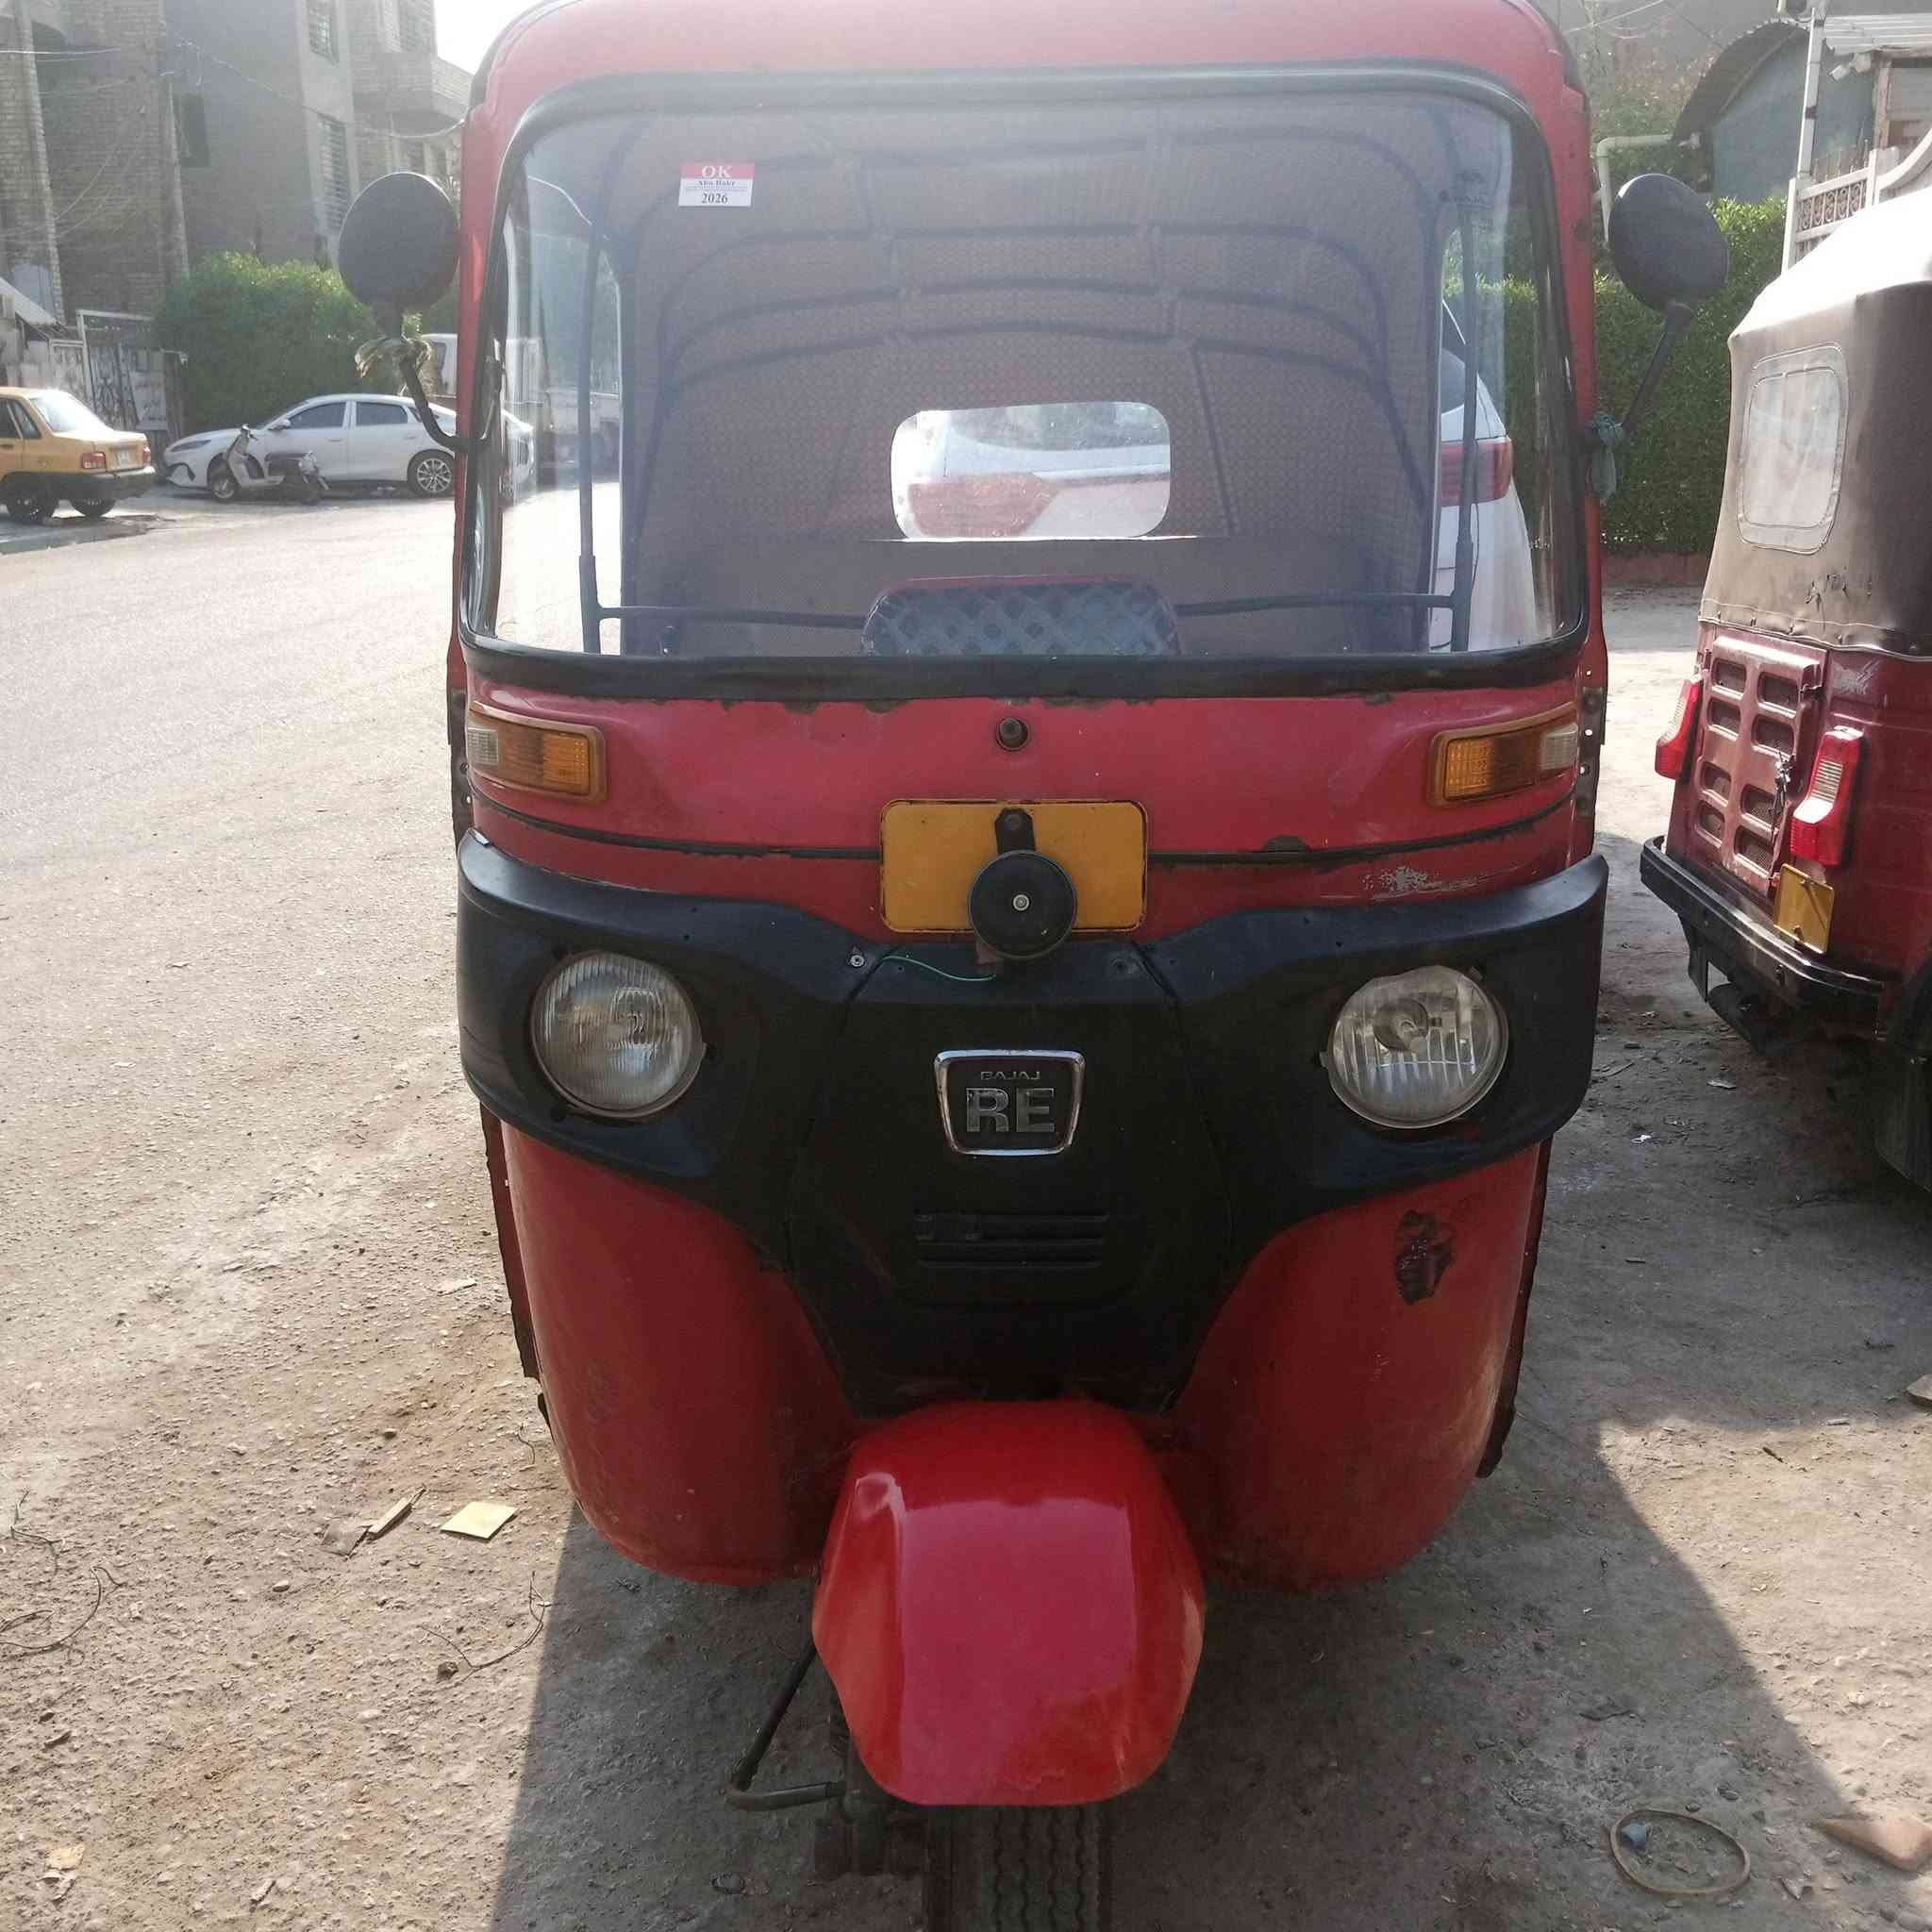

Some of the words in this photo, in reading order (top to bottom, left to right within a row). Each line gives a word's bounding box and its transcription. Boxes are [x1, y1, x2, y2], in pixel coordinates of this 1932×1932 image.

[701, 165, 732, 179] OK
[701, 192, 728, 204] 2026
[980, 1071, 1041, 1080] BAJAJ
[965, 1088, 1056, 1133] RE
